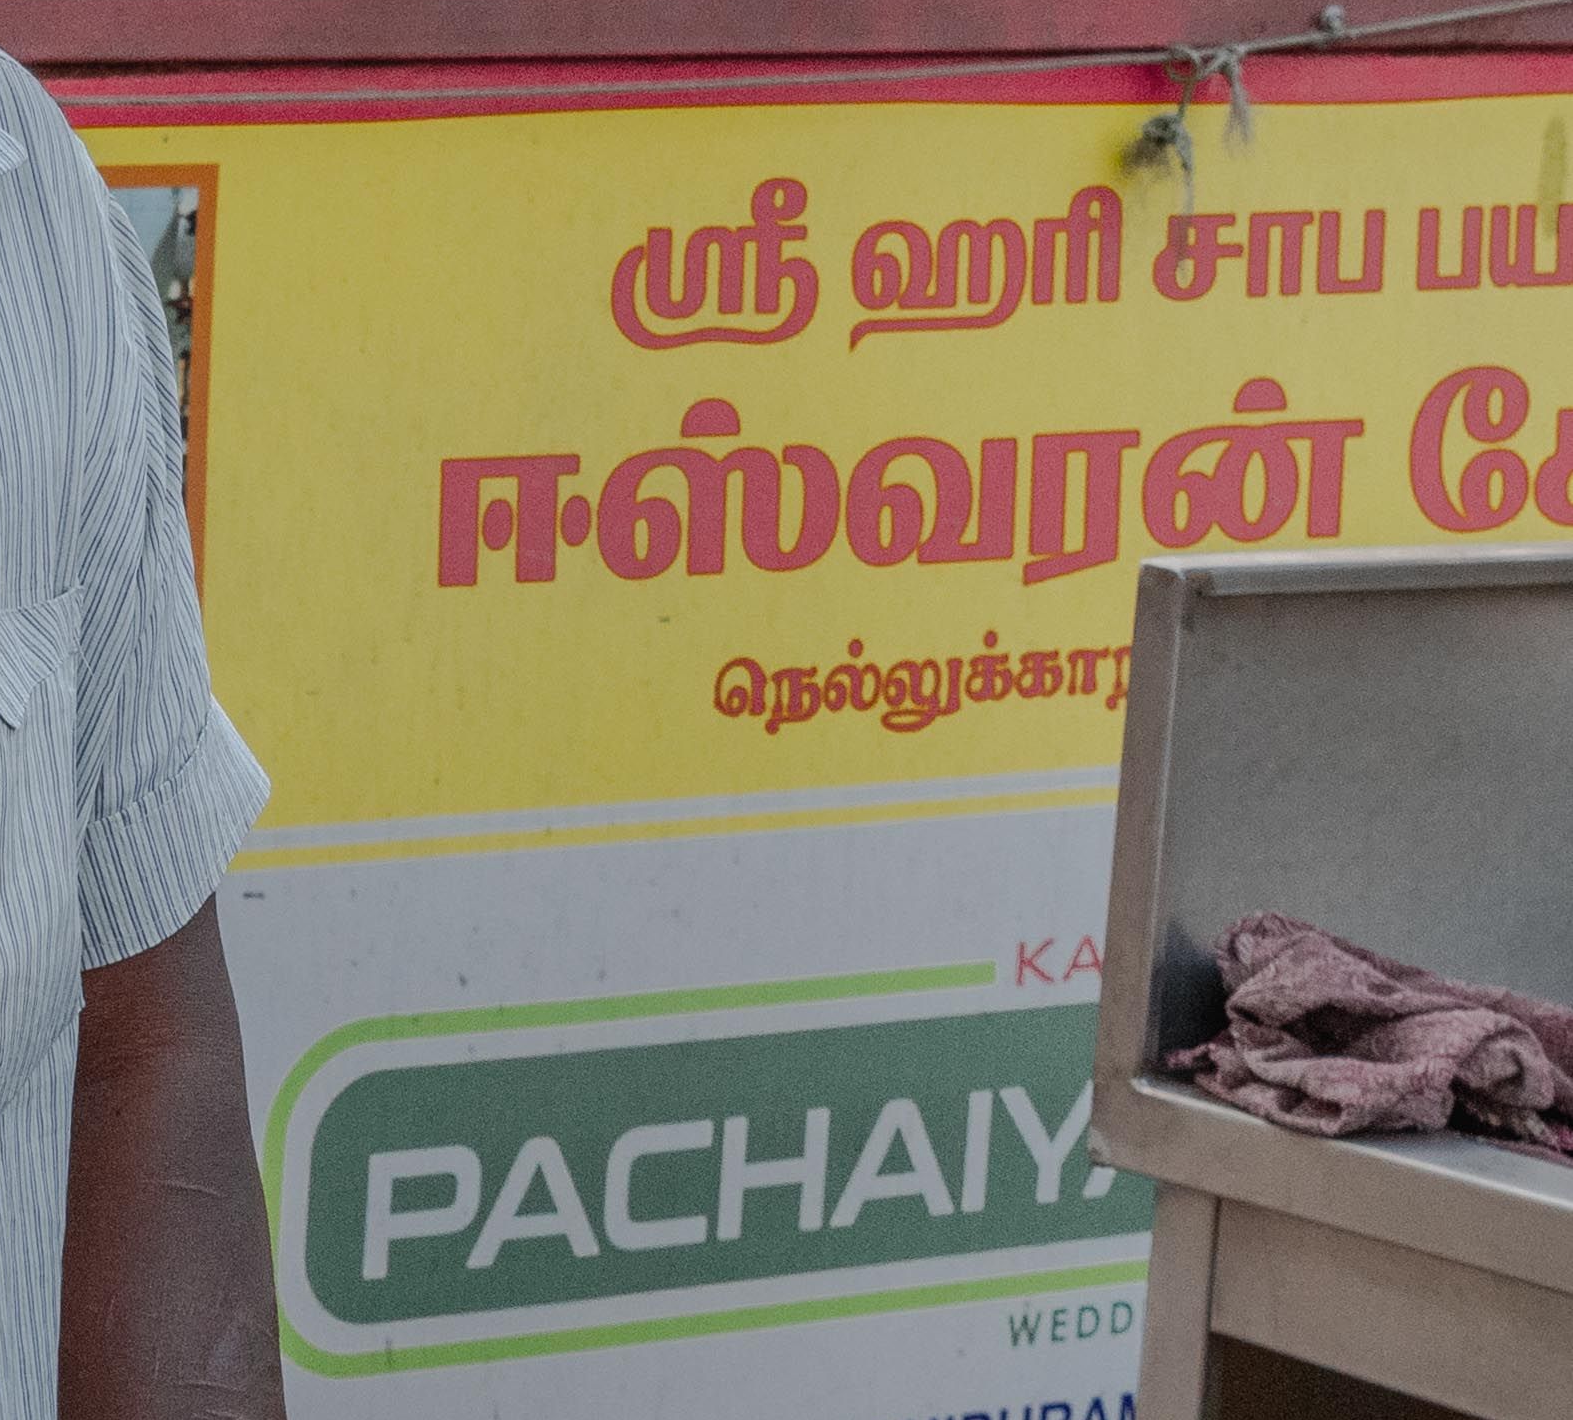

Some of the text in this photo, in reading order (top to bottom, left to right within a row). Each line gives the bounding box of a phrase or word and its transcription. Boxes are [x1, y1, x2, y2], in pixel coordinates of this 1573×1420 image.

[848, 184, 1125, 353] ஹரி
[1151, 208, 1387, 303] சாப
[437, 376, 1365, 588] ஈஸ்வரன்
[361, 1078, 1117, 1282] PACHAIY
[1008, 1299, 1134, 1348] WEDD
